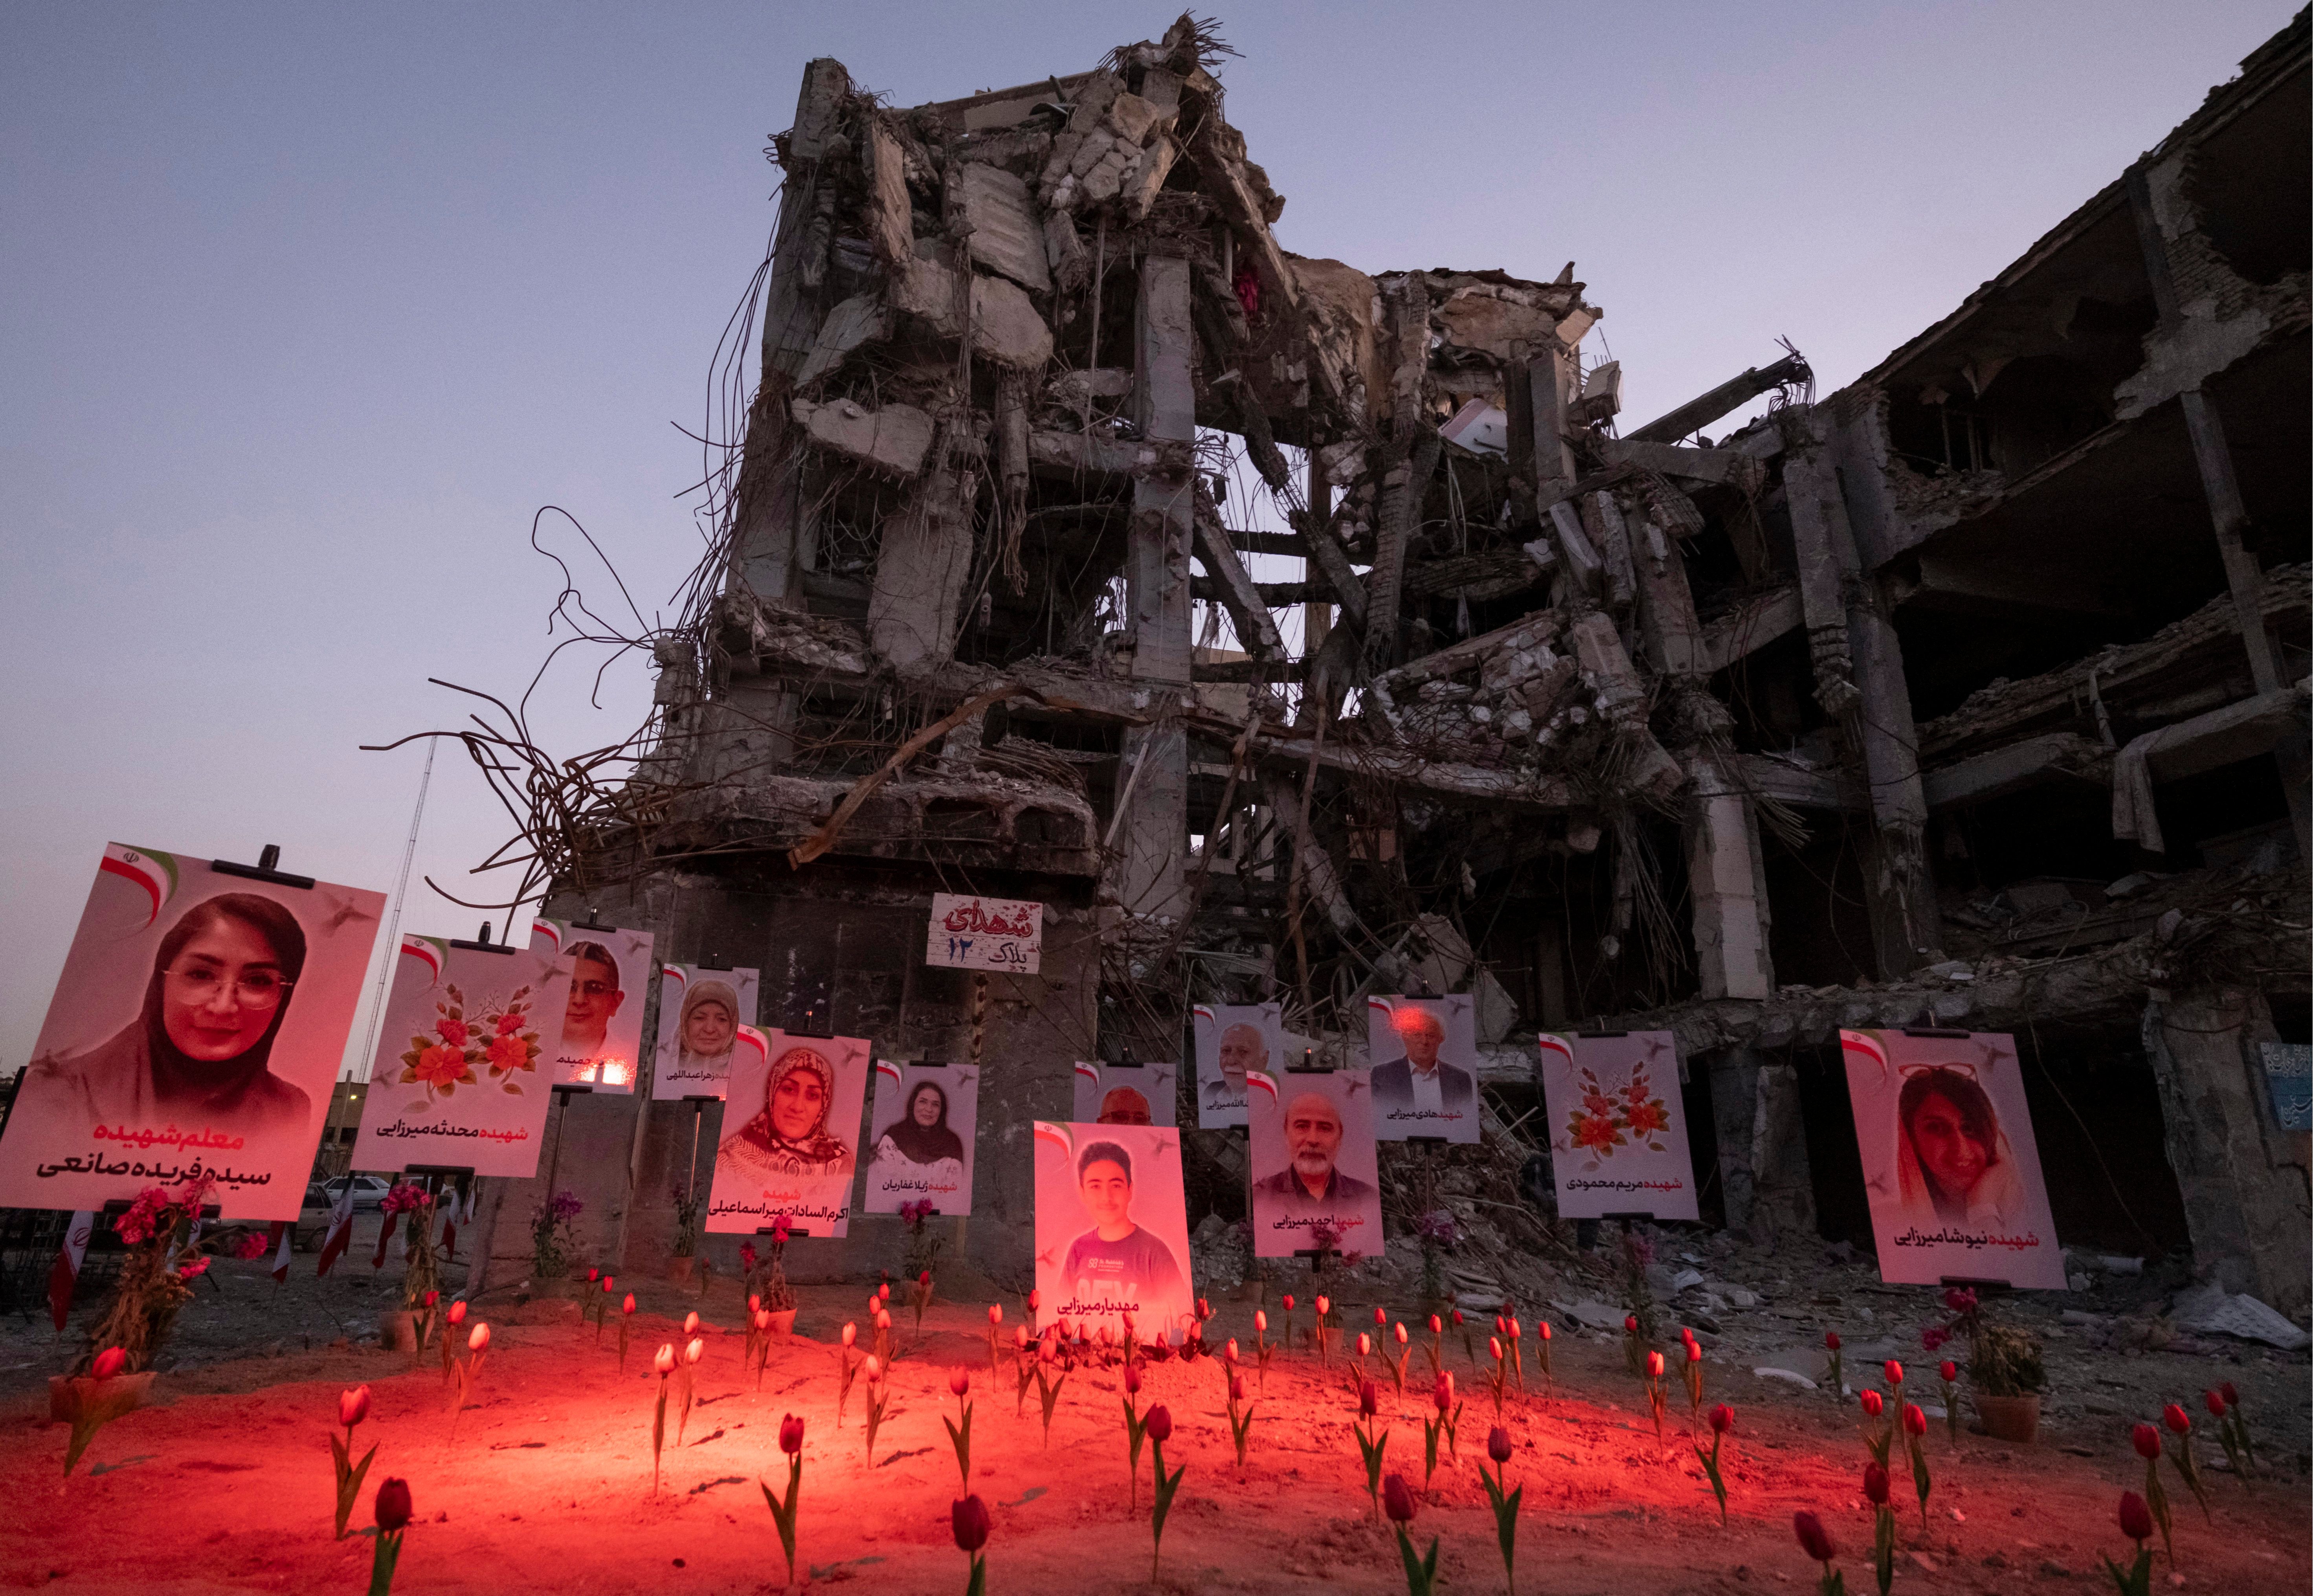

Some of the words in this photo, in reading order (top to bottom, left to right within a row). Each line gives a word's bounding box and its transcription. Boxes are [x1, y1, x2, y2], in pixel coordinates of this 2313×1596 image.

[944, 898, 1033, 937] شهدای
[949, 937, 973, 962] ۱۲
[989, 942, 1026, 972] پلاک
[666, 1070, 701, 1081] عبداللهی
[701, 1071, 714, 1081] زهرا
[714, 1073, 730, 1082] یده
[1206, 1100, 1230, 1110] میرزایی
[1387, 1108, 1415, 1119] میرزایی
[1416, 1109, 1437, 1119] هادی
[1437, 1110, 1463, 1121] شهید
[376, 1118, 429, 1138] میرزایی
[431, 1119, 479, 1138] محدثه
[479, 1127, 528, 1144] شهیده
[93, 1124, 180, 1149] شهیده
[178, 1127, 244, 1152] معلم
[37, 1152, 130, 1178] صانعی
[132, 1157, 202, 1186] فریده
[204, 1167, 271, 1190] سیده
[883, 1179, 913, 1191] غفاریان
[1567, 1179, 1615, 1190] محمودی
[1616, 1179, 1643, 1192] مریم
[1644, 1178, 1682, 1192] شهیده
[914, 1181, 928, 1192] ژیلا
[929, 1182, 957, 1193] شهیده
[763, 1189, 801, 1203] شهیده
[826, 1207, 848, 1222] اکرم
[1273, 1214, 1308, 1229] میرزایی
[1308, 1214, 1335, 1225] احمد
[1894, 1227, 1944, 1247] میرزایی
[1943, 1228, 1987, 1248] نیوشا
[1989, 1231, 2039, 1251] شهیده
[1057, 1297, 1100, 1315] میرزایی
[1100, 1297, 1138, 1315] مهدیار
